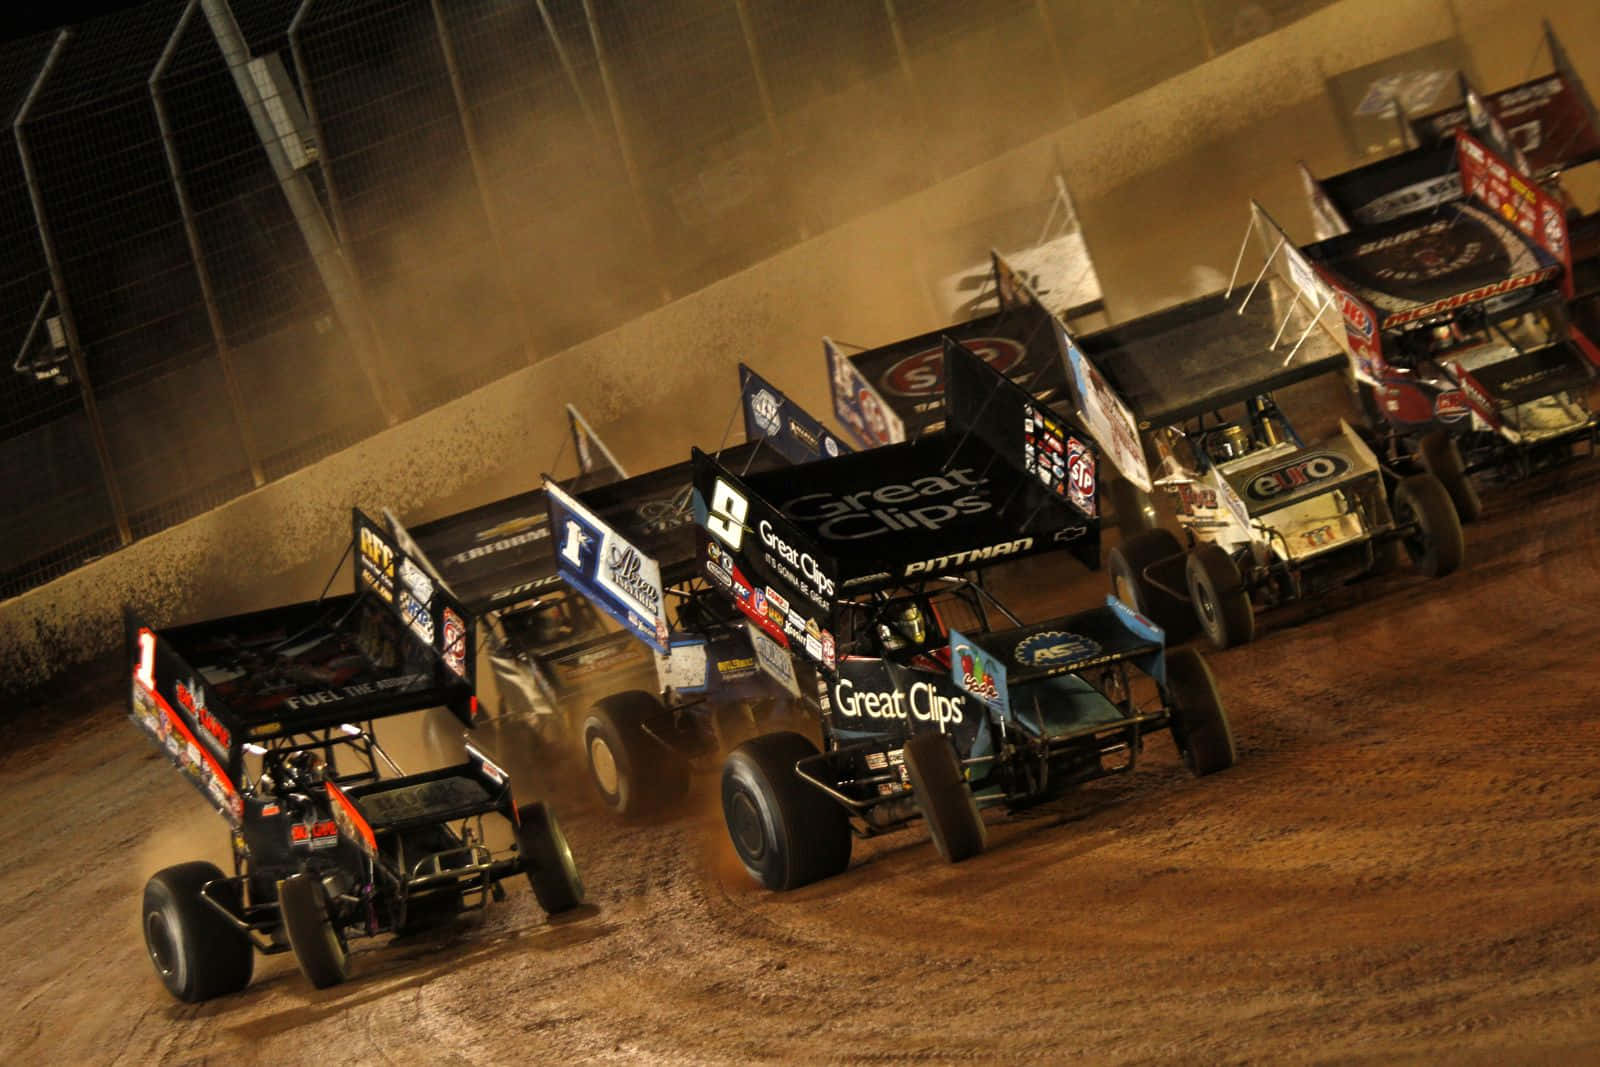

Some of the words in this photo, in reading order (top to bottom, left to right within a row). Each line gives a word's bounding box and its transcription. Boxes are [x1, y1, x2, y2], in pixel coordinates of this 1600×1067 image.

[784, 467, 985, 521] Great
[1071, 459, 1092, 489] STP
[1254, 457, 1336, 496] euro
[707, 478, 749, 552] 9
[817, 493, 992, 541] Clips
[759, 519, 800, 569] Great
[800, 552, 835, 597] Clips
[904, 536, 1035, 577] PITTMAN
[133, 627, 158, 693] 1
[287, 688, 345, 711] FUEL
[834, 678, 908, 719] Great
[910, 681, 965, 734] Clips
